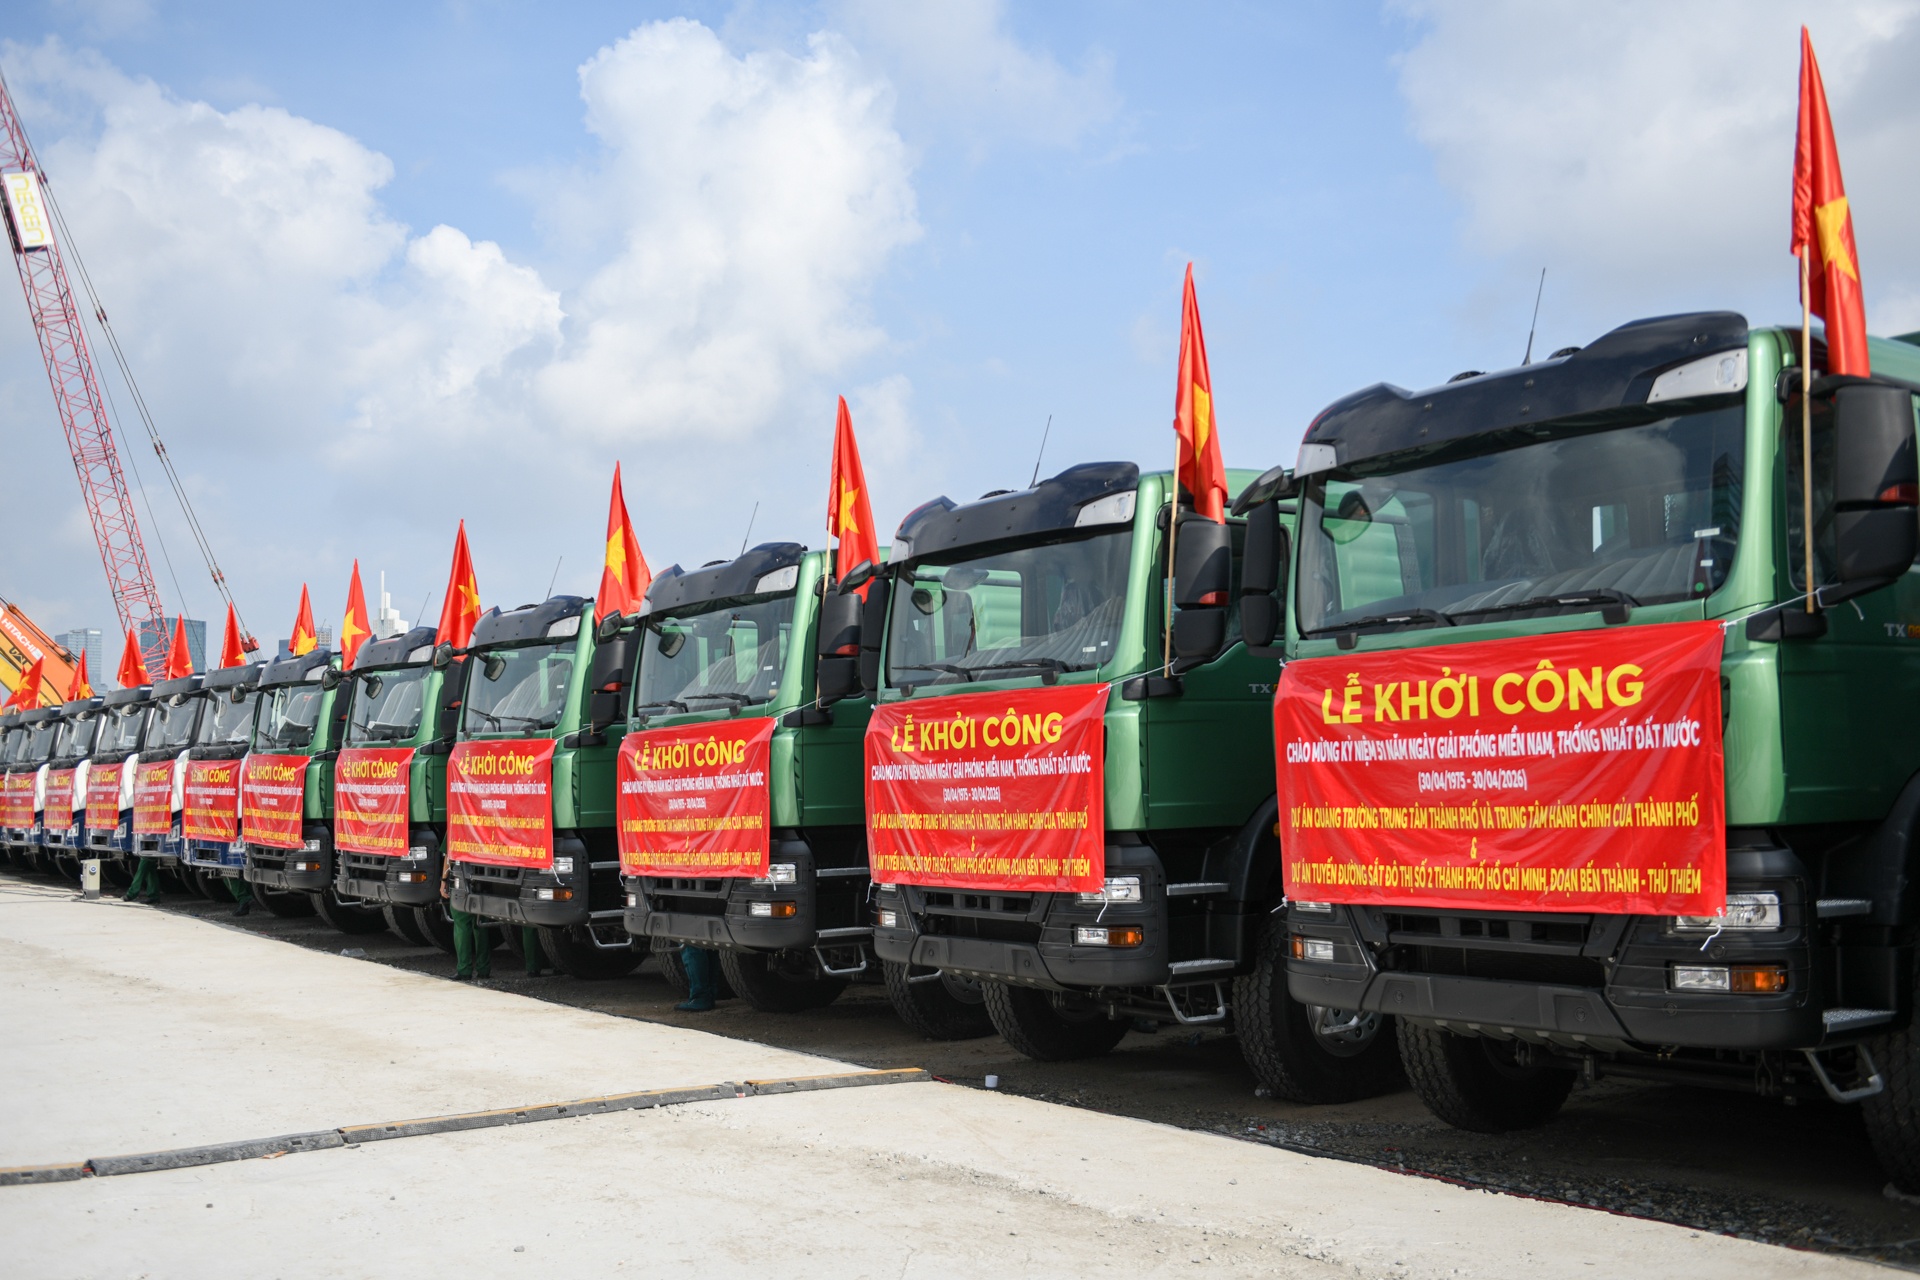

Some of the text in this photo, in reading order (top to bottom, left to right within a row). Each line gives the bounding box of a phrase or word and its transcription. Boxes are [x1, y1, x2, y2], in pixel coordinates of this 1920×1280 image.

[1, 618, 37, 653] HITACHI
[1321, 659, 1644, 725] LỄ KHỞI CÔNG
[890, 707, 1063, 752] LỄ KHỞI CÔNG
[1287, 737, 1310, 763] CHÀO
[1311, 736, 1339, 762] MỪNG
[1386, 733, 1408, 761] NĂM
[1408, 731, 1436, 760] NGÀY
[1437, 729, 1457, 759] GIẢI
[1459, 729, 1496, 758] PHÓNG
[1498, 725, 1524, 757] MIỀN
[1527, 731, 1555, 759] NAM,
[1557, 721, 1600, 754] THỐNG
[1600, 717, 1634, 752] NHẤT
[1635, 715, 1660, 750] ĐẤT
[1662, 715, 1700, 748] NƯỚC
[352, 757, 369, 778] KHỞI
[371, 757, 399, 778] CÔNG
[470, 751, 496, 775] KHỞI
[498, 750, 535, 775] CÔNG
[634, 736, 746, 771] LỄ KHỞI CÔNG
[1418, 770, 1466, 792] (30/04/1975
[1472, 768, 1527, 791] 30/04/2026)
[1291, 792, 1699, 833] DỰ ÁN QUẢNG TRƯỜNG TRUNG TÂM THÀNH PHỐ VÀ TRUNG TÂM HÀNH CHÍNH CỦA THÀNH PHỐ
[1470, 837, 1477, 860] &
[1291, 861, 1300, 888] DỰ
[1301, 857, 1311, 883] ÁN
[1312, 856, 1337, 884] TUYẾN
[1338, 859, 1367, 886] ĐƯỜNG
[1368, 857, 1384, 887] SẮT
[1385, 860, 1398, 888] ĐÔ
[1399, 866, 1413, 893] THỊ
[1414, 858, 1427, 888] SỐ
[1427, 866, 1433, 889] 2
[1434, 861, 1464, 889] THÀNH
[1466, 859, 1486, 890] PHỐ
[1486, 859, 1500, 891] HỒ
[1502, 862, 1519, 891] CHÍ
[1521, 867, 1549, 895] MINH,
[1550, 868, 1578, 897] ĐOẠN
[1580, 860, 1600, 892] BẾN
[1602, 862, 1639, 893] THÀNH
[1648, 862, 1668, 893] THỦ
[1670, 862, 1701, 894] THIÊM
